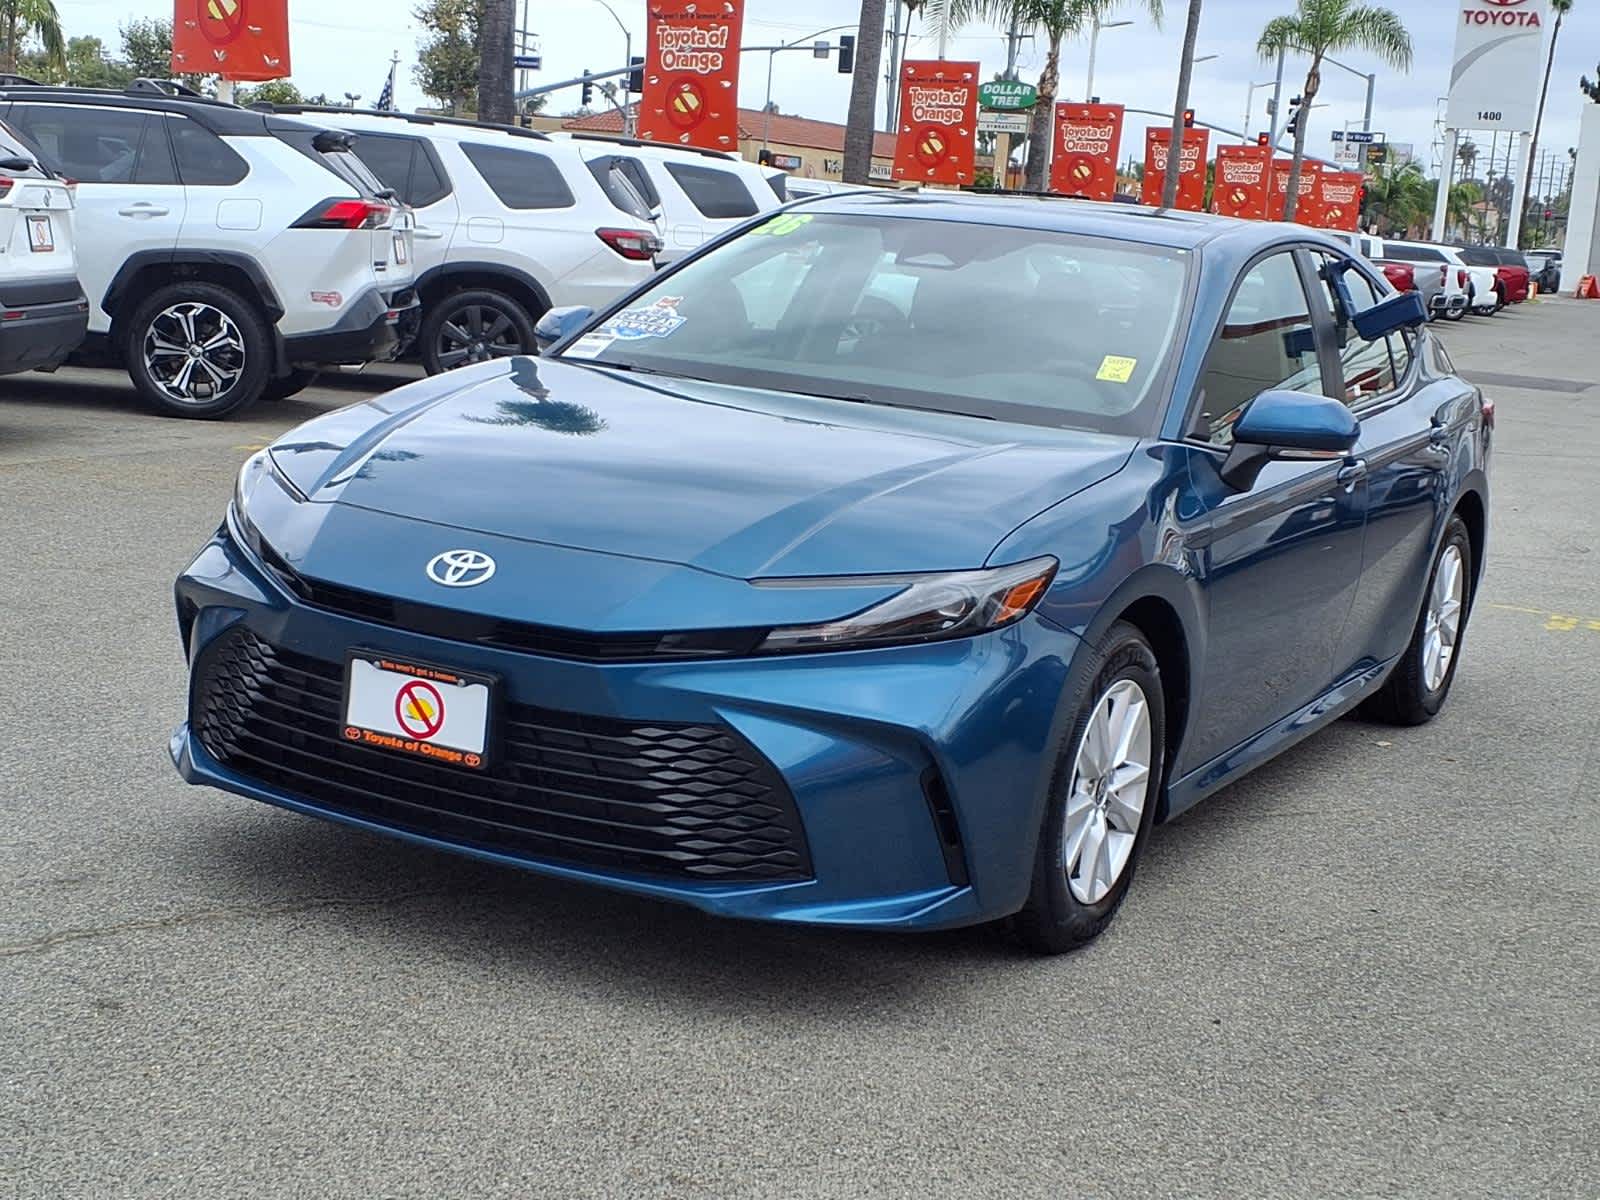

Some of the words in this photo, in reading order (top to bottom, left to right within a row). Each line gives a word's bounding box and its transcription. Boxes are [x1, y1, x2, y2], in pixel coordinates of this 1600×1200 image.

[1463, 10, 1541, 27] TOYOTA
[657, 26, 707, 49] Toyota
[708, 26, 728, 48] of
[661, 49, 723, 73] Orange
[909, 87, 951, 106] Toyota
[952, 88, 968, 105] of
[983, 84, 1031, 95] DOLLAR
[991, 95, 1021, 106] TREE
[913, 105, 963, 125] Orange
[1477, 111, 1502, 121] 1400
[1062, 124, 1098, 141] Toyota
[1099, 126, 1112, 139] of
[1065, 139, 1108, 155] Orange
[1152, 145, 1185, 158] Toya
[1186, 147, 1200, 159] of
[1155, 156, 1195, 172] Oge
[1222, 161, 1251, 173] Toyota
[1252, 162, 1263, 172] of
[1224, 173, 1259, 184] Orange
[1305, 174, 1315, 184] of
[395, 664, 415, 673] won't
[363, 730, 403, 748] Toyota
[405, 742, 419, 751] of
[420, 744, 463, 761] Orange
